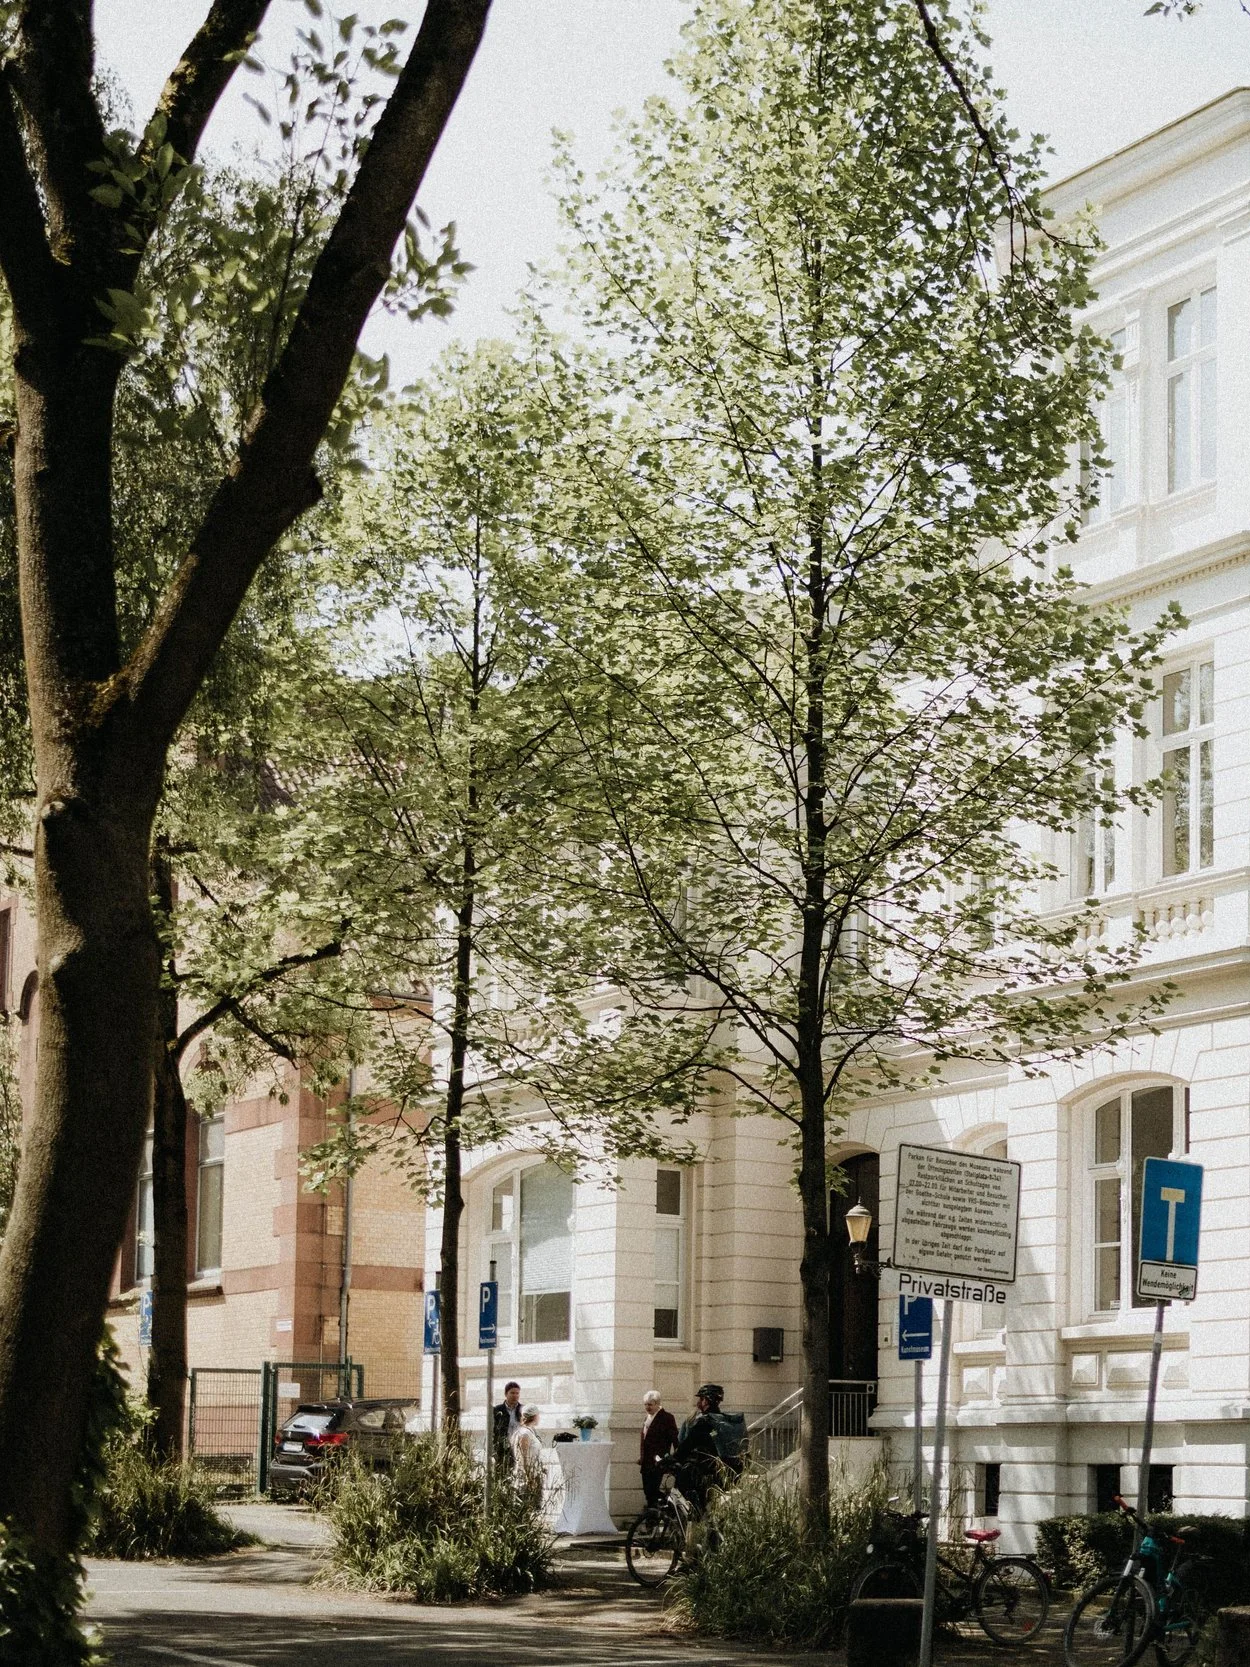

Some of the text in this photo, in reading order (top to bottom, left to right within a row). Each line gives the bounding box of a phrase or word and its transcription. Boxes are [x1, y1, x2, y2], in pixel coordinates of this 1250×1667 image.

[908, 1153, 924, 1161] Parken
[935, 1157, 956, 1166] Besucher
[969, 1162, 990, 1171] Museums
[993, 1166, 1012, 1174] während
[927, 1164, 962, 1176] Öffnungszeiten
[948, 1185, 974, 1194] Mitarbeiter
[986, 1191, 1007, 1199] Besucher
[964, 1179, 990, 1190] Schultagen
[915, 1189, 950, 1200] Goethe-Schule
[968, 1197, 1000, 1207] VHS-Besucher
[921, 1199, 940, 1207] sichtbar
[916, 1209, 936, 1218] während
[974, 1218, 1007, 1228] widerrechtlich
[901, 1216, 930, 1227] abgestellten
[932, 1221, 956, 1231] Fahrzeuge
[977, 1227, 1011, 1239] kostenpflichtig
[918, 1248, 934, 1256] eigene
[936, 1250, 951, 1258] Gefahr
[973, 1255, 991, 1263] werden.
[921, 1239, 939, 1248] übrigen
[974, 1247, 995, 1256] Parkplatz
[1160, 1270, 1177, 1279] Keine
[899, 1273, 1006, 1305] Privatstraße
[1142, 1278, 1194, 1292] Wendemöglichkeit
[427, 1295, 436, 1319] P
[482, 1287, 491, 1313] P
